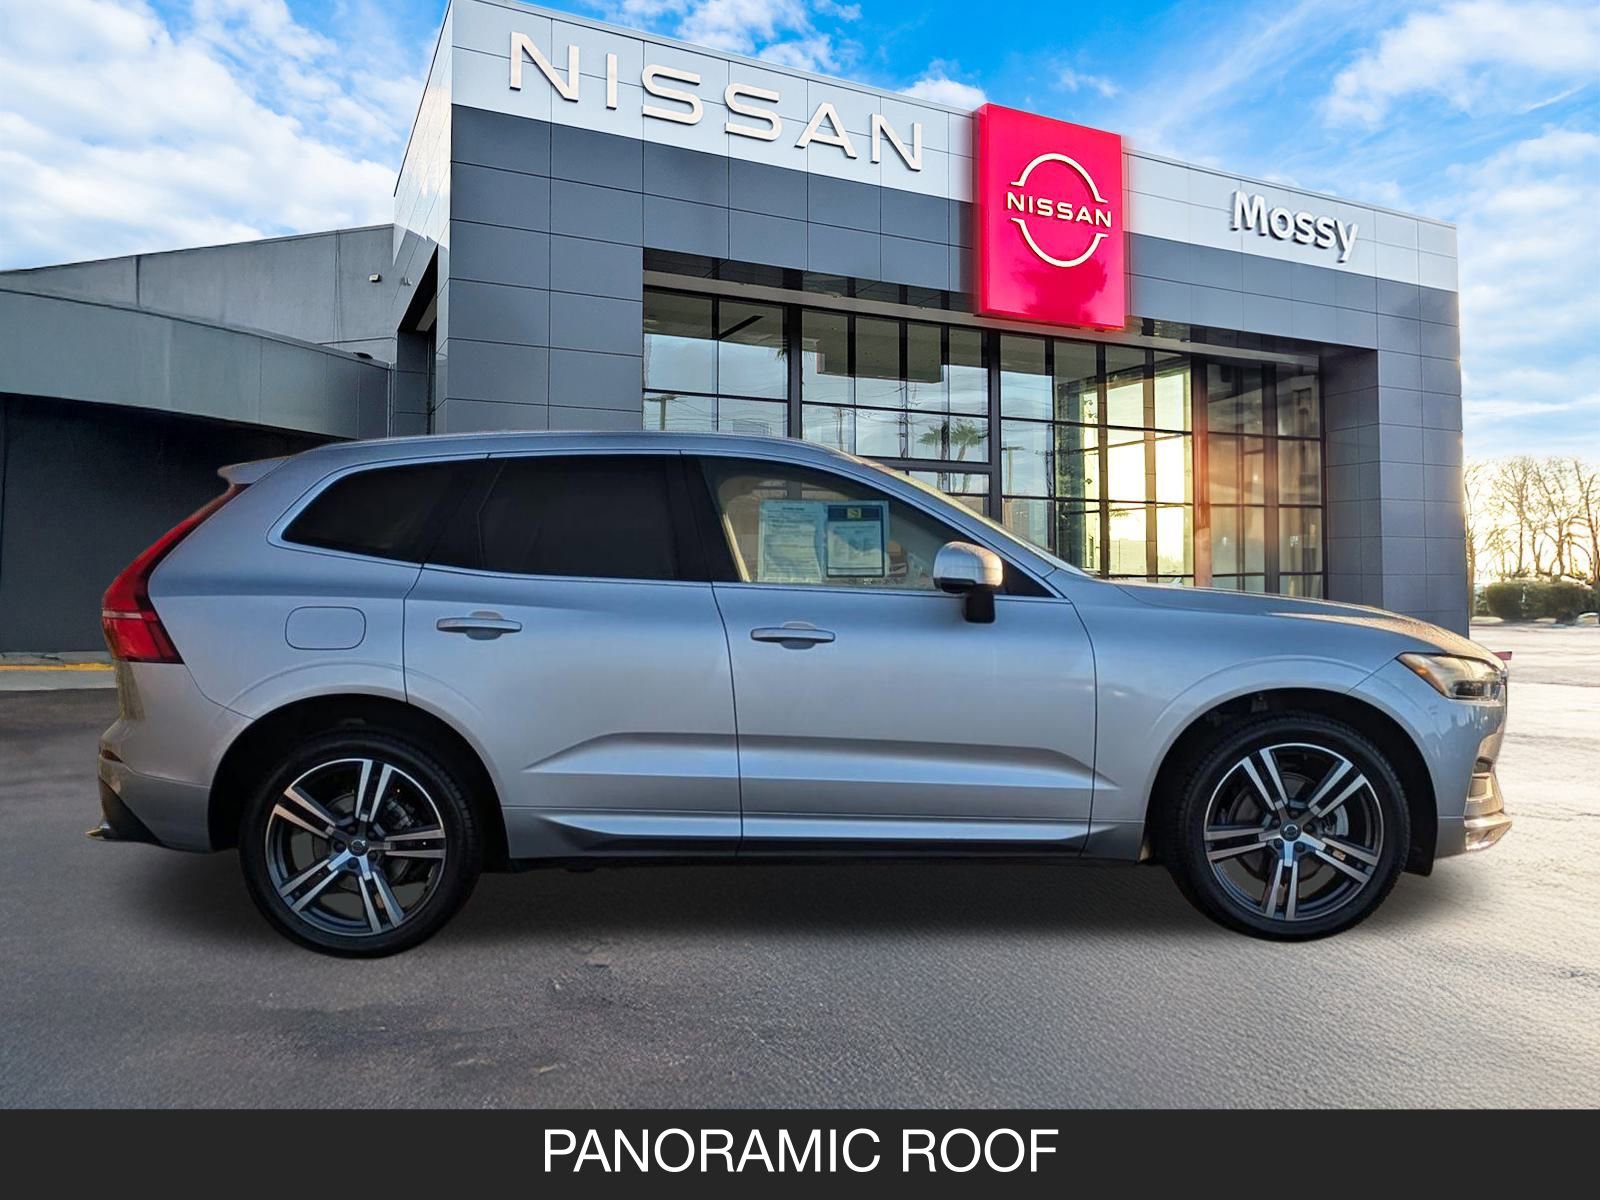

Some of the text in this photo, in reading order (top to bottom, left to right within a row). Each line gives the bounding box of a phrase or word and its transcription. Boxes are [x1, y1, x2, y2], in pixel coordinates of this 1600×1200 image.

[509, 31, 923, 172] NISSAN
[1006, 191, 1112, 228] NISSAN
[1231, 190, 1360, 264] Mossy
